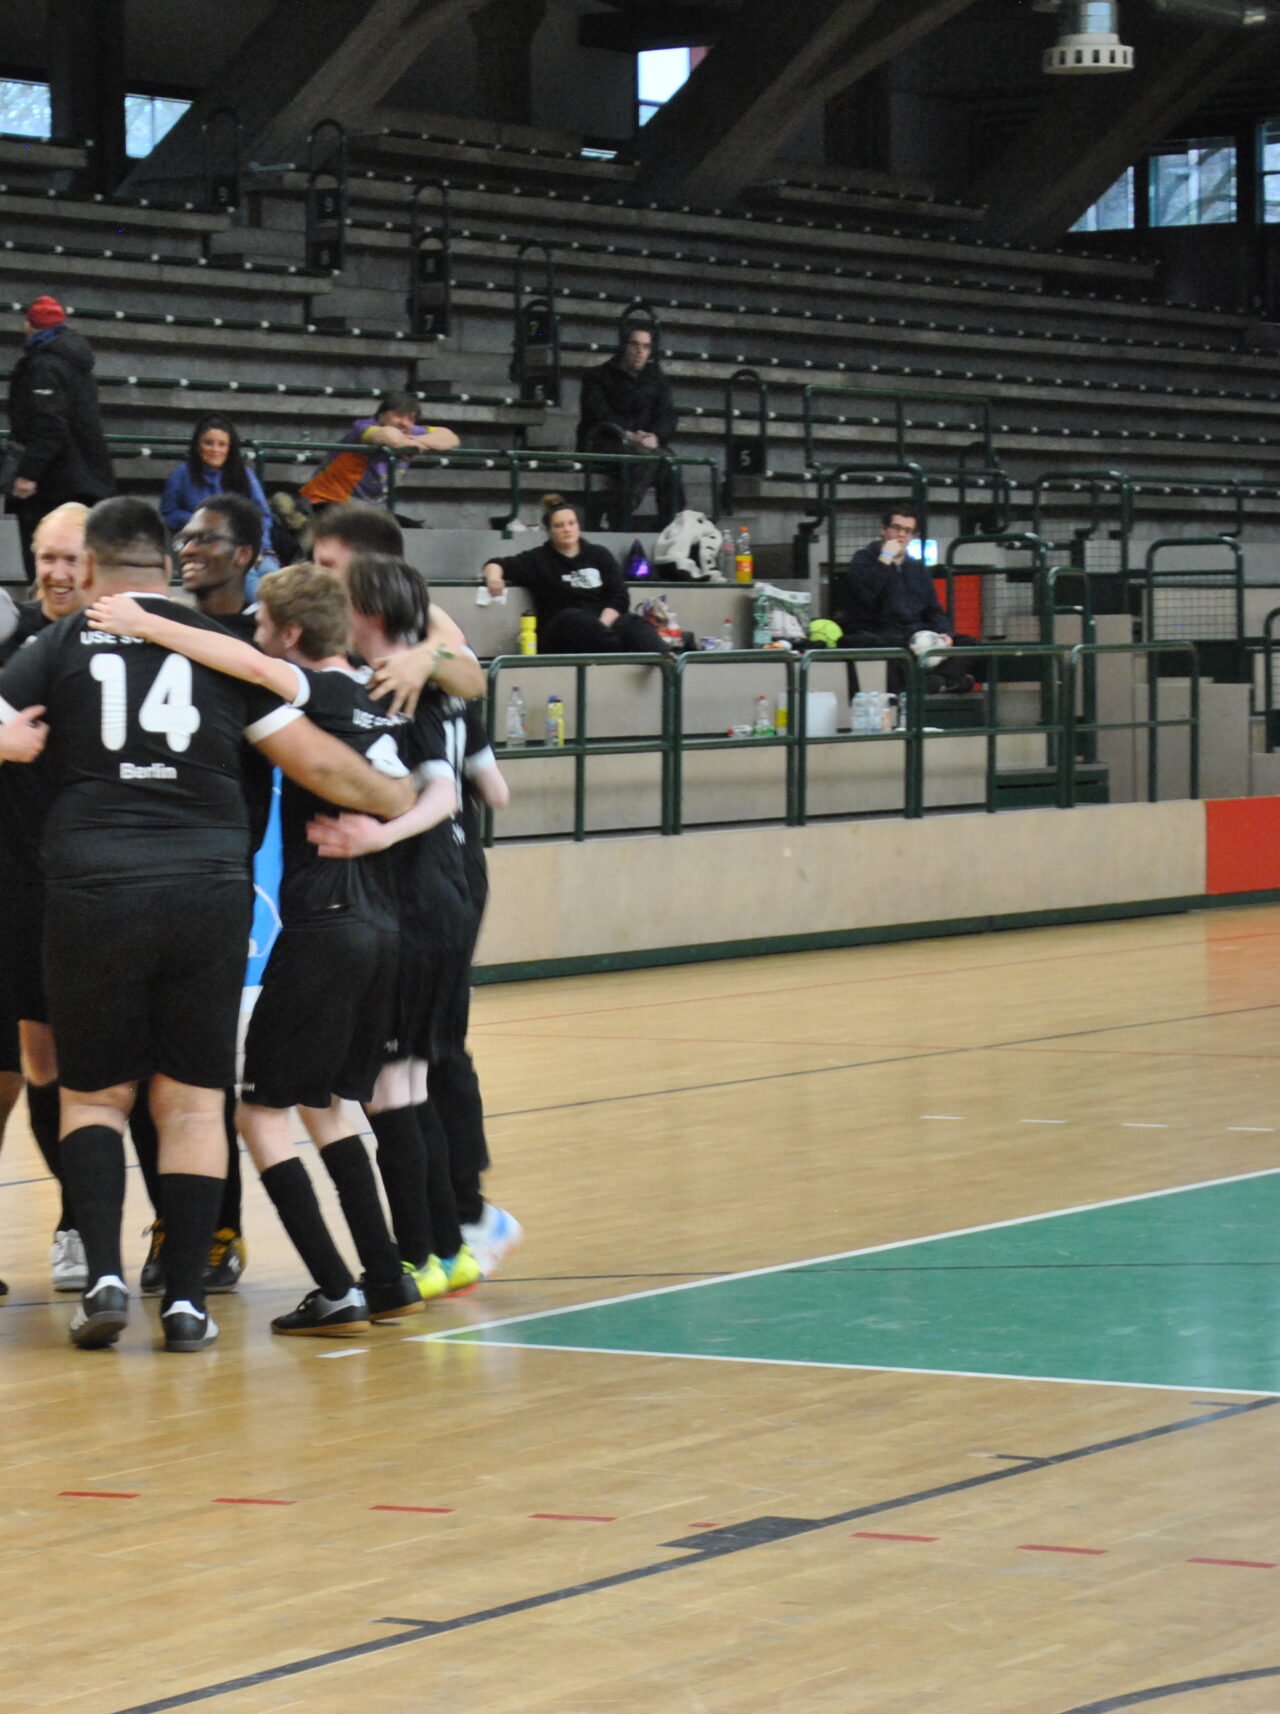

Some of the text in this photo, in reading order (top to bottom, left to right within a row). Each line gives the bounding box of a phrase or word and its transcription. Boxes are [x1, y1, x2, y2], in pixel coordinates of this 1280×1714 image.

[740, 450, 752, 467] 5
[89, 652, 201, 753] 14
[119, 761, 179, 780] Berlin
